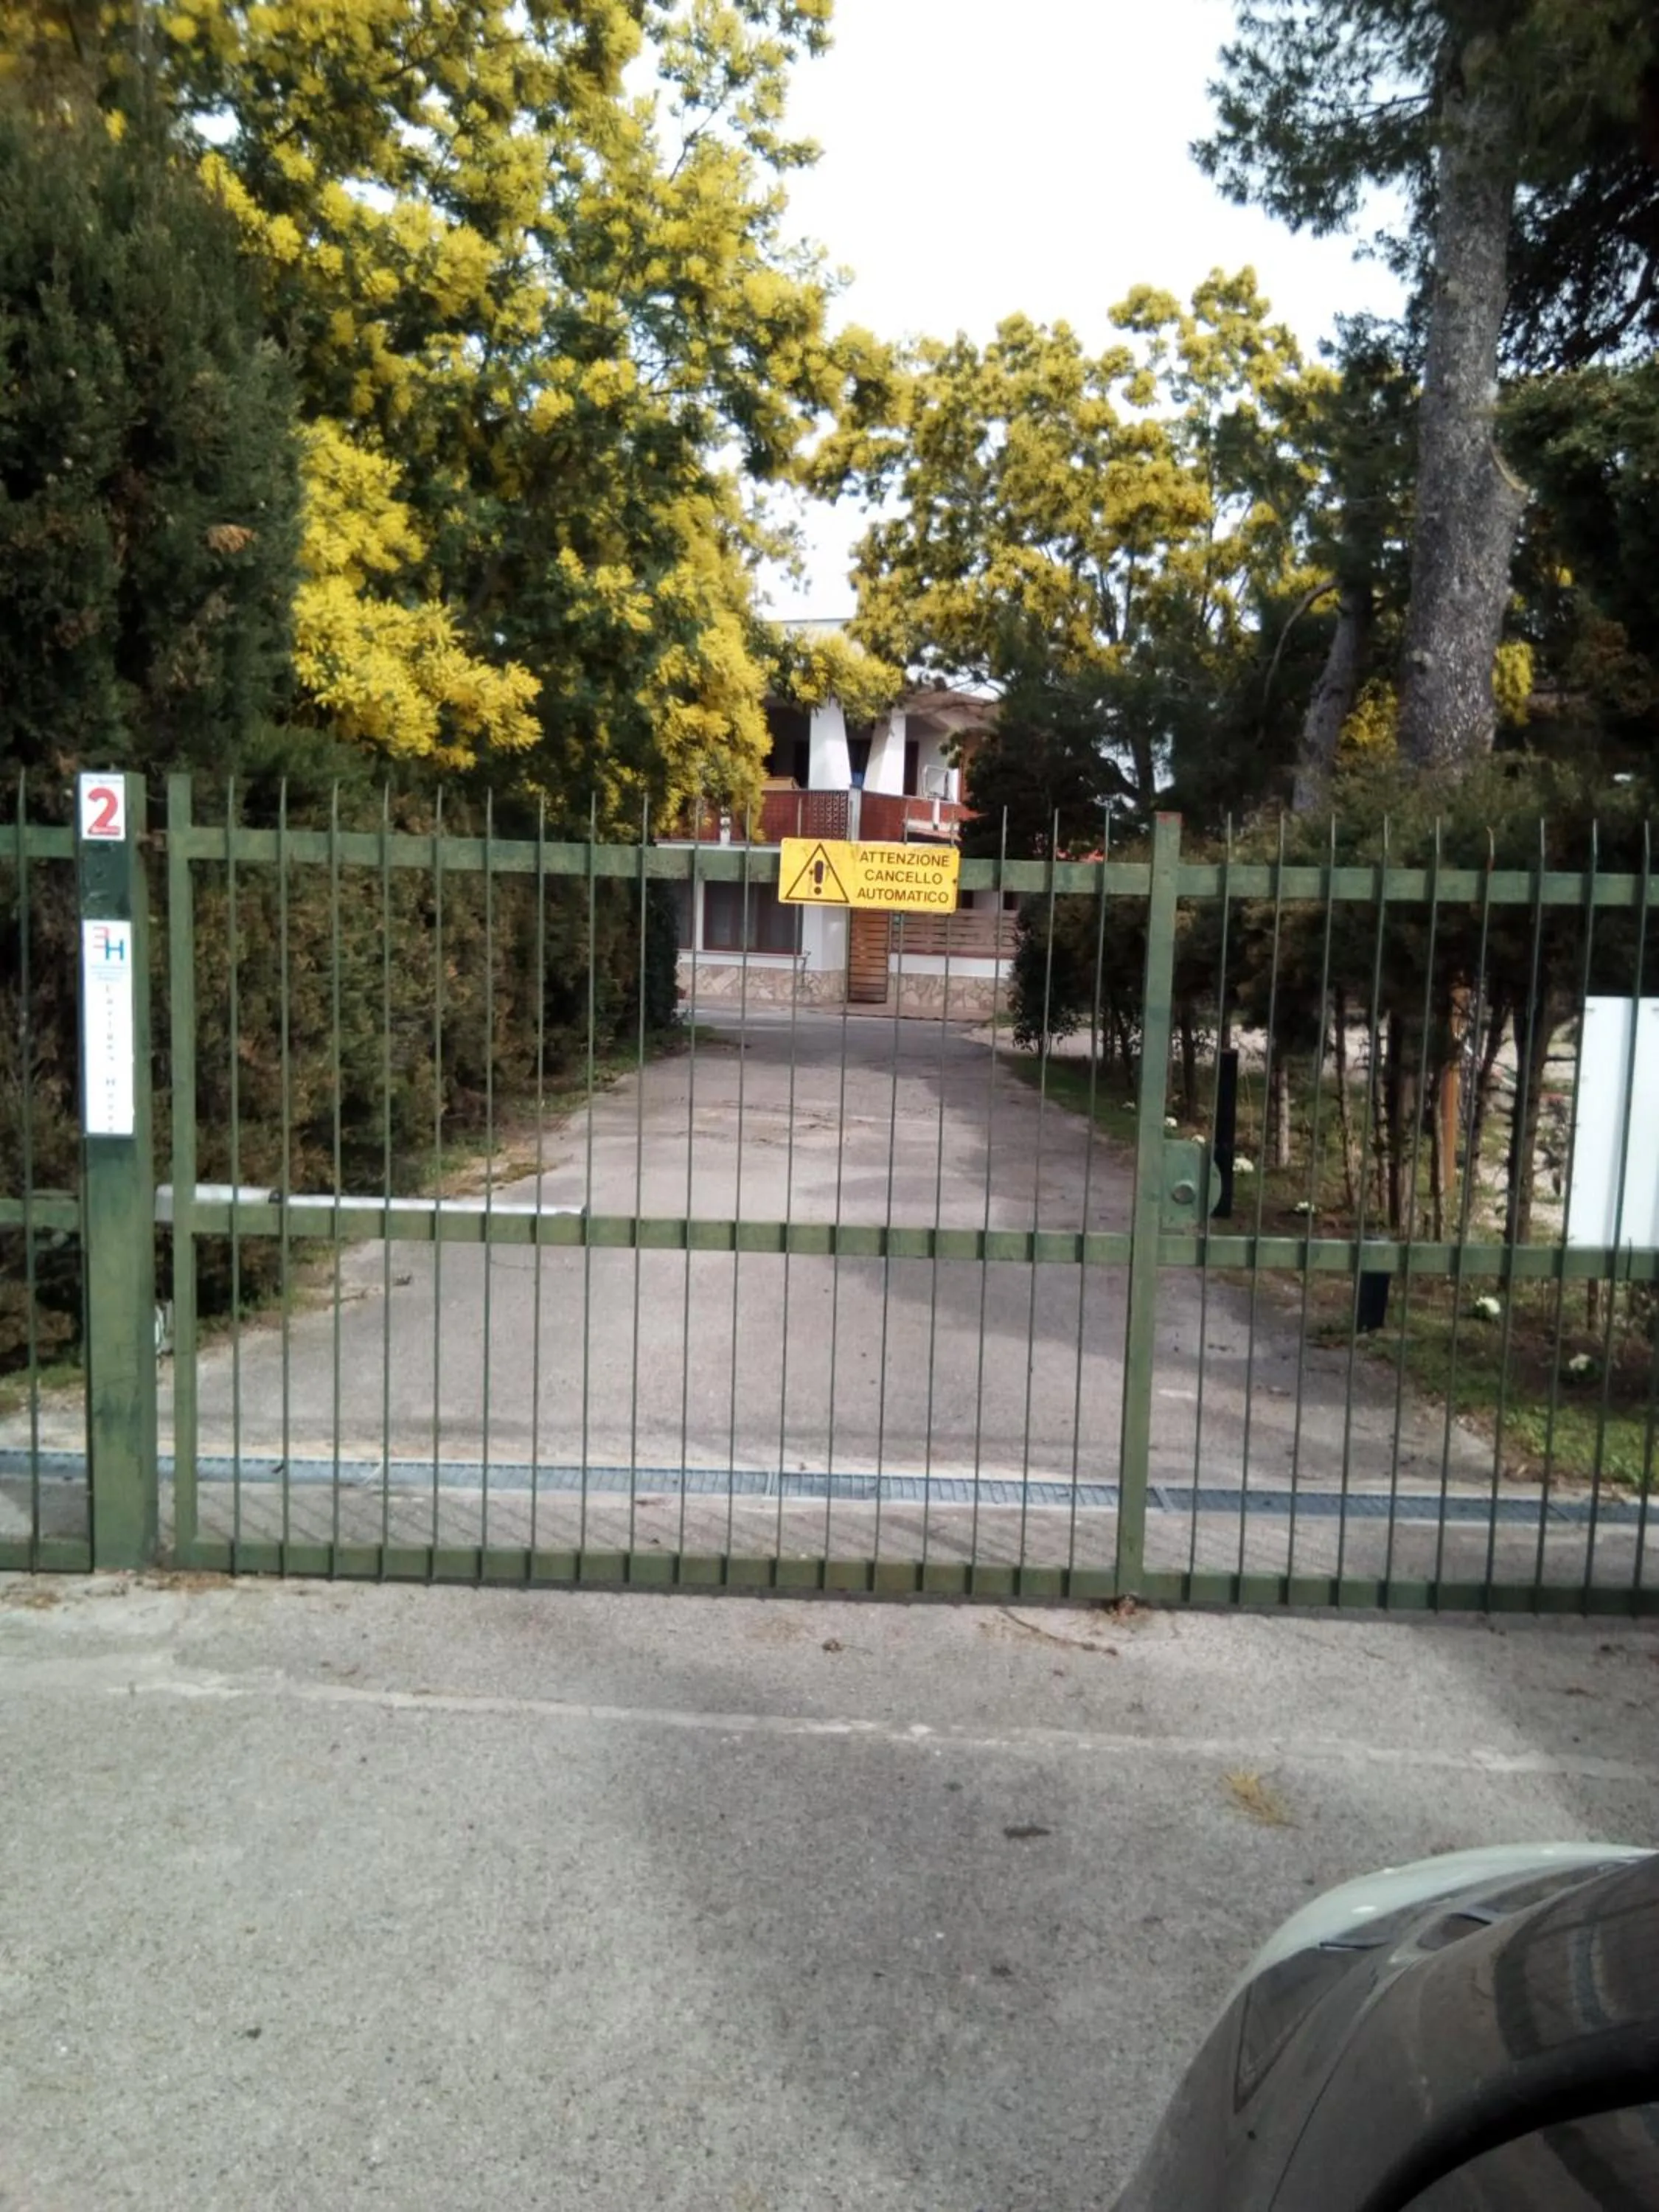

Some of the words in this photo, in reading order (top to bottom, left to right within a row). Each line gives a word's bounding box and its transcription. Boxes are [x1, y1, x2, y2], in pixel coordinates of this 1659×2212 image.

[87, 787, 122, 837] 2
[859, 851, 950, 867] ATTENZIONE
[864, 869, 943, 886] CANCELLO
[857, 887, 949, 904] AUTOMATICO
